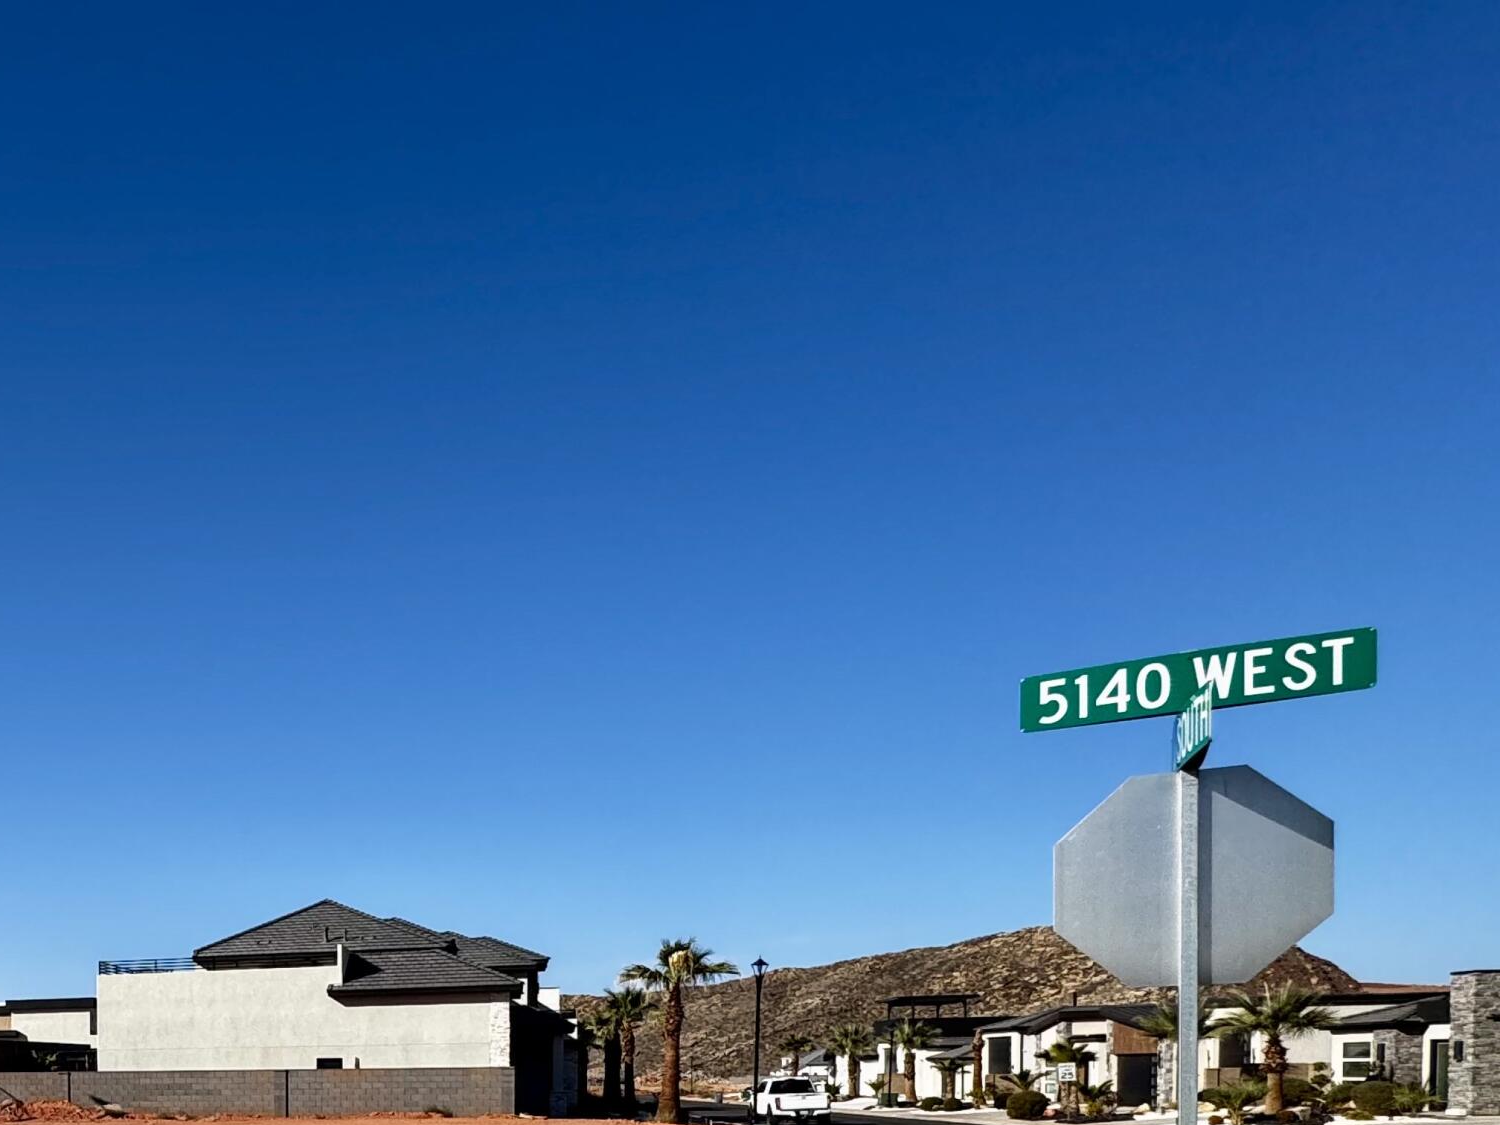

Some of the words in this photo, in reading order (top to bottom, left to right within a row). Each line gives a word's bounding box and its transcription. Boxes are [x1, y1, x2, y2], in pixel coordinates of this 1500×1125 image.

[1038, 662, 1172, 725] 5140
[1192, 636, 1355, 700] WEST
[1176, 681, 1213, 764] SOUTH
